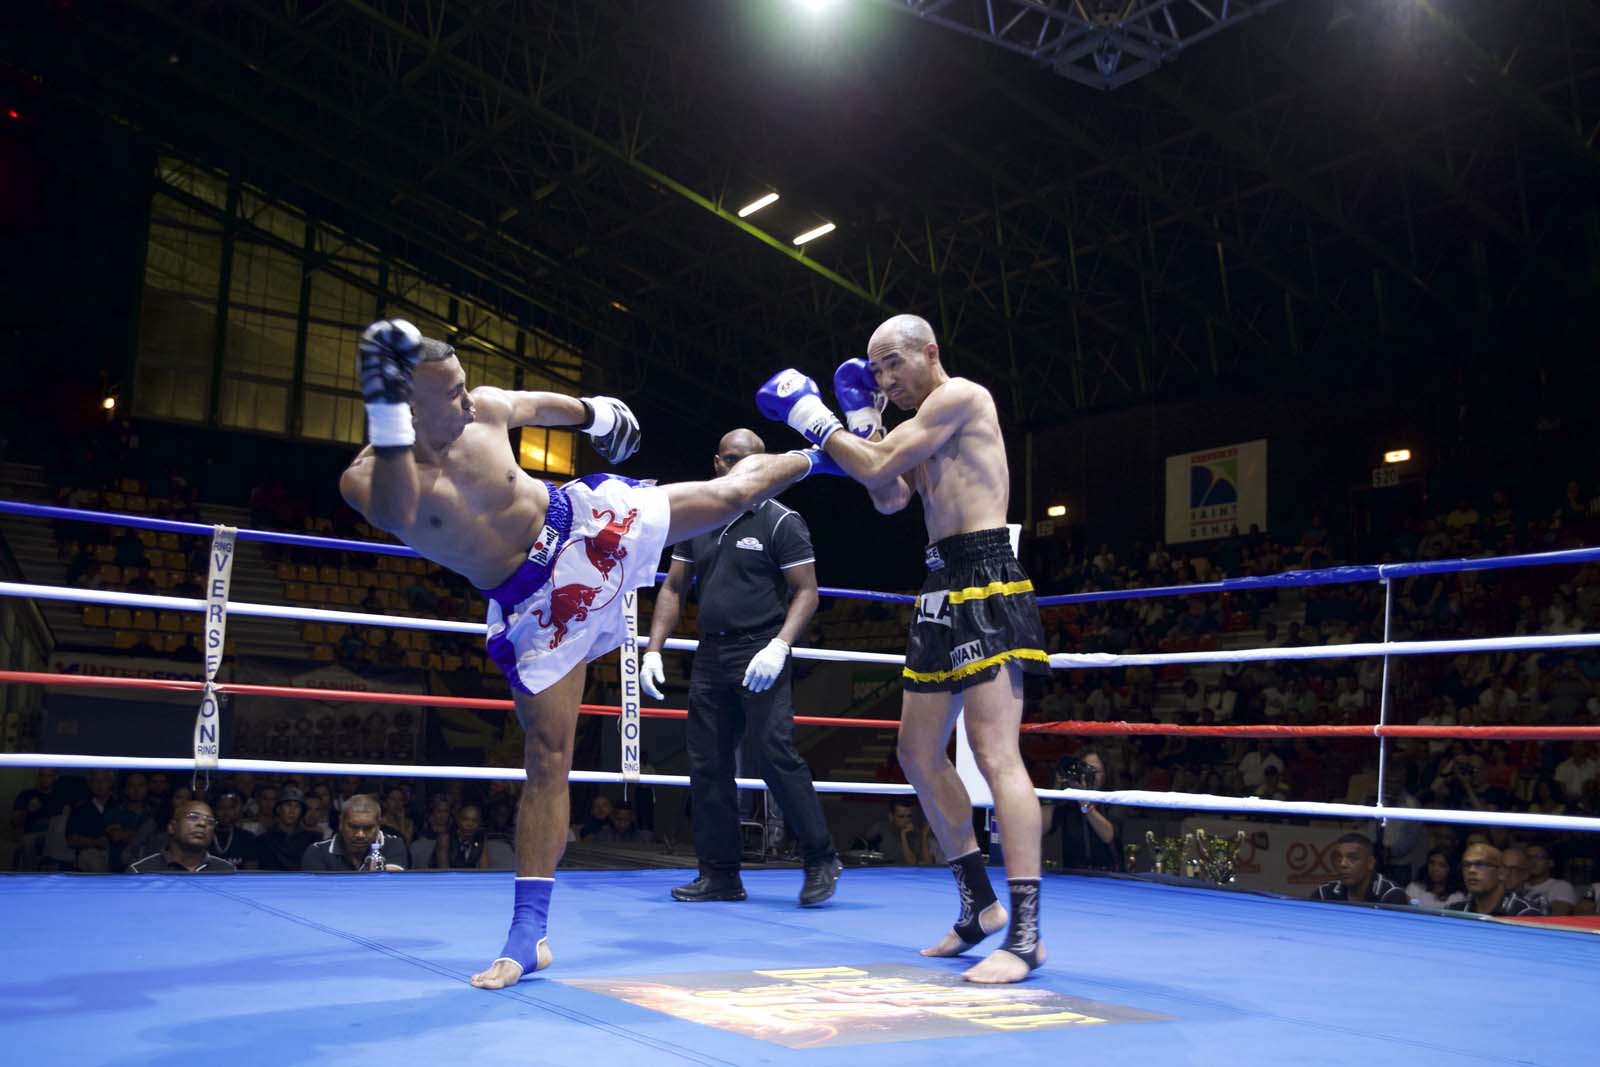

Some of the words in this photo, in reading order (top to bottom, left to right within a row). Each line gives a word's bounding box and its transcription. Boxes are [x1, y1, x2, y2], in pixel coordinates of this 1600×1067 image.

[199, 553, 230, 744] VERSEON
[82, 663, 206, 681] INTERSPOR
[197, 745, 217, 755] RING
